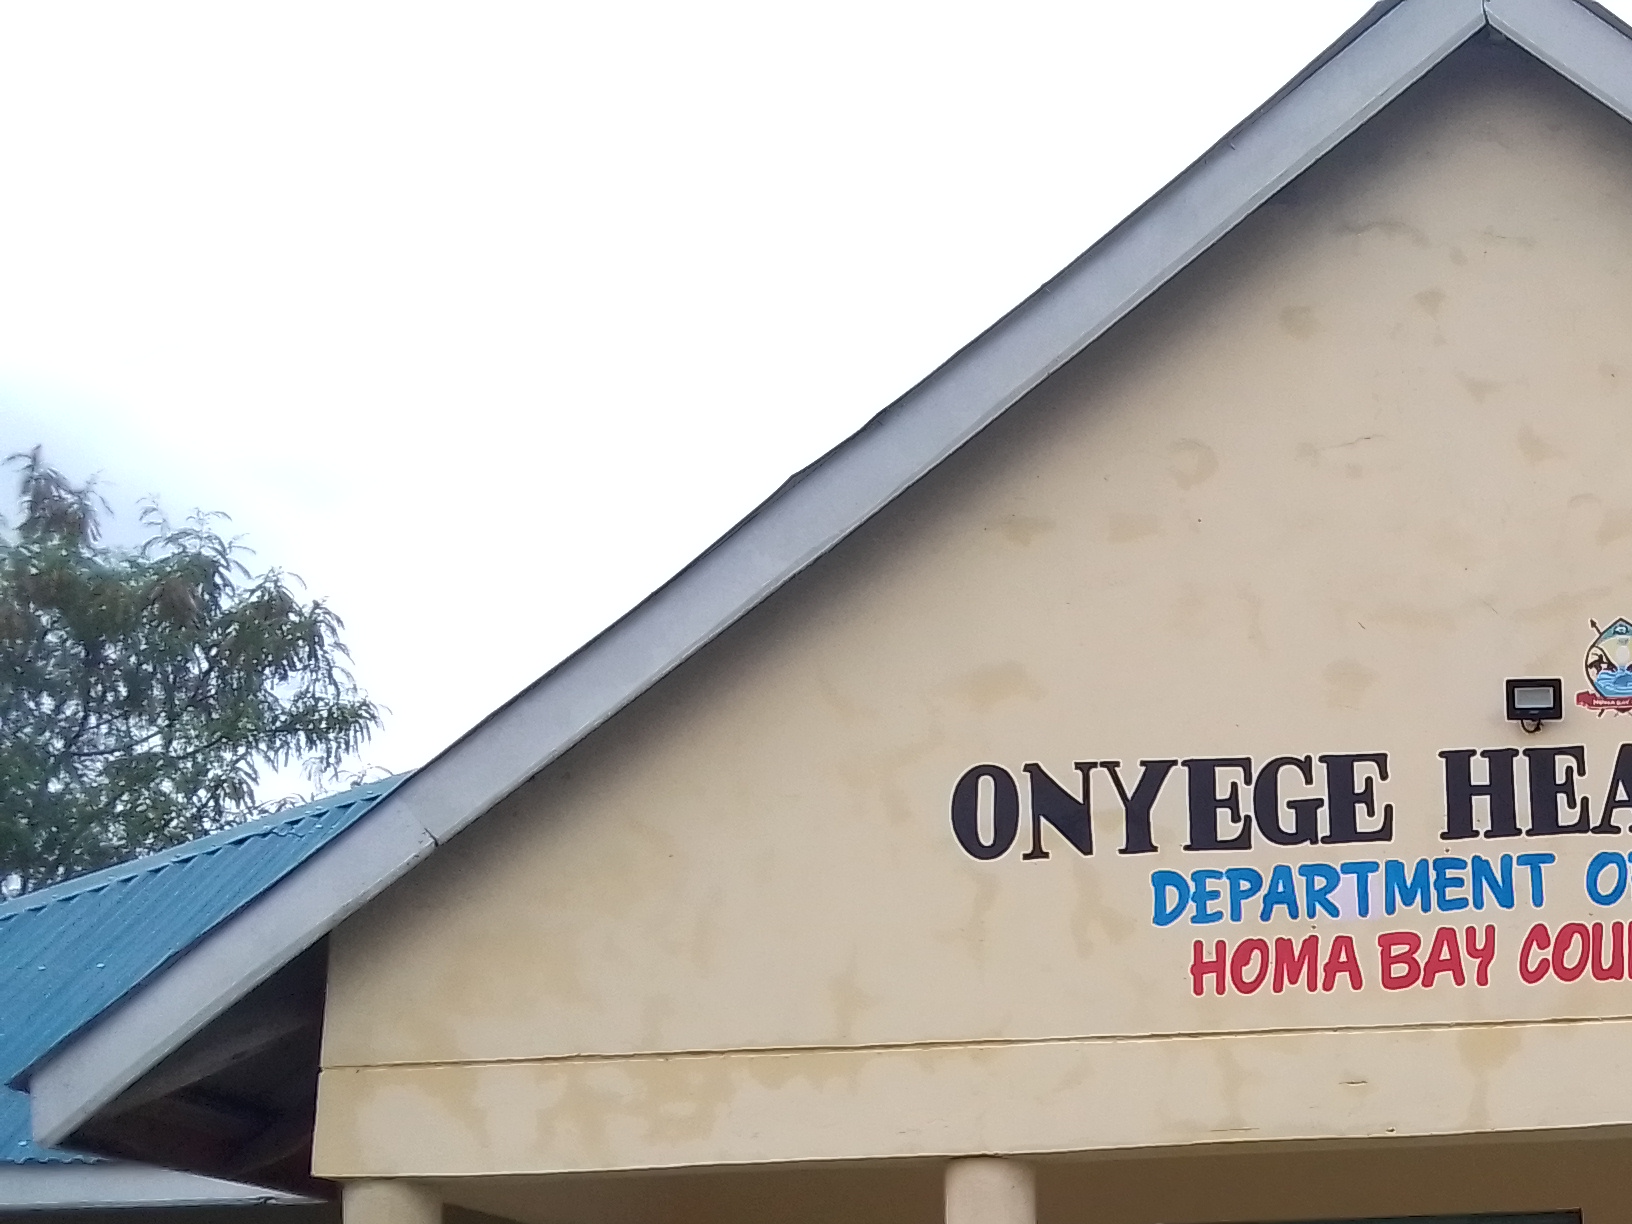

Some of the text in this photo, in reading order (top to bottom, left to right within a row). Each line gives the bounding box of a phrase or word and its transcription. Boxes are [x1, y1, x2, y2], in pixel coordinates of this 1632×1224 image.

[951, 752, 1394, 861] ONYEGE
[1151, 853, 1555, 927] DEPARTMENT
[1189, 935, 1363, 997] HOMA
[1377, 925, 1495, 991] BAY
